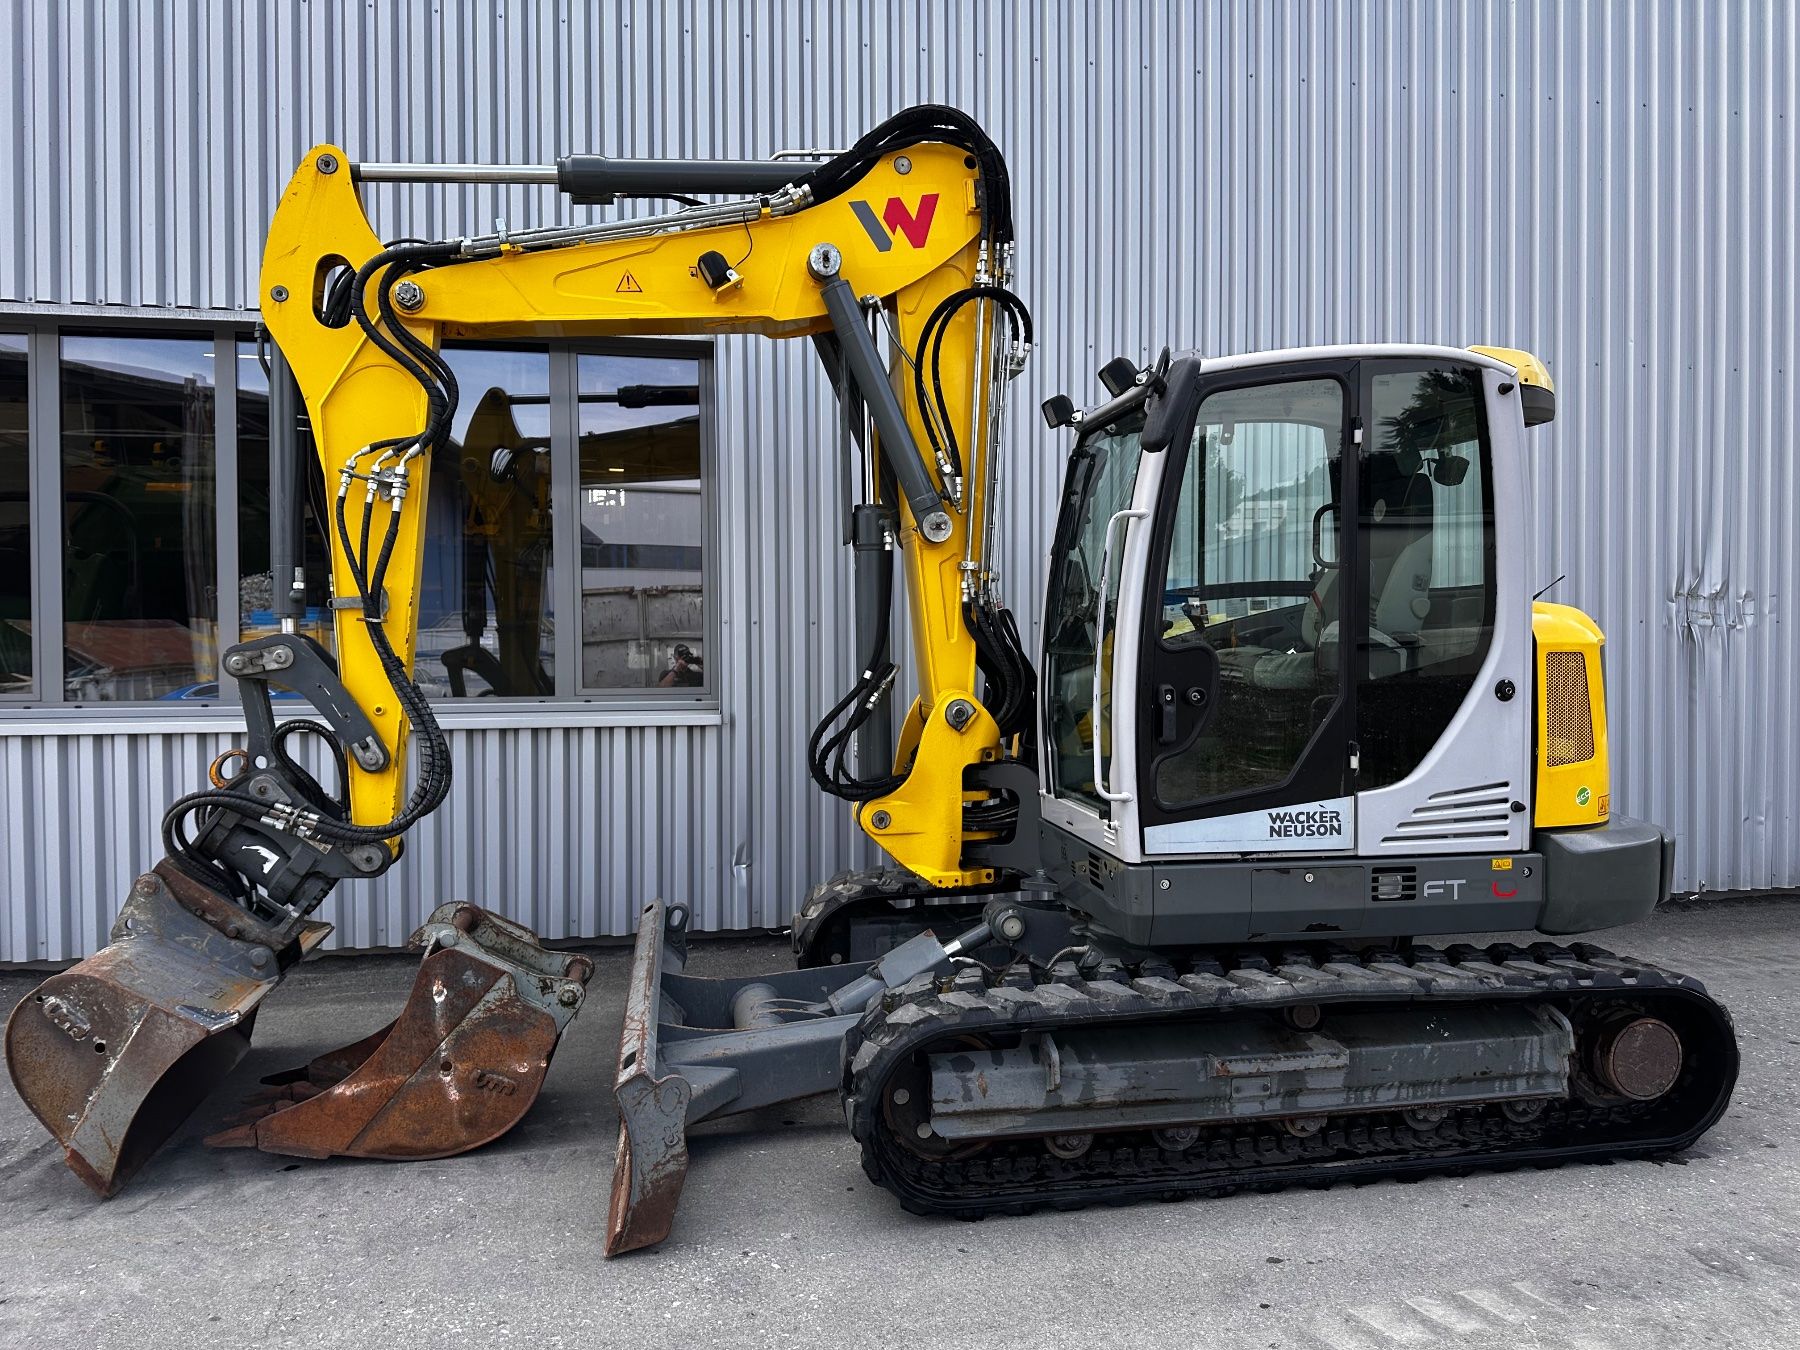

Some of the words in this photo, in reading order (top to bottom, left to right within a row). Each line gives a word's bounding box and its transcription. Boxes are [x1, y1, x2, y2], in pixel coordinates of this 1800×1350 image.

[848, 193, 940, 253] W
[1267, 810, 1342, 825] WACKER
[1269, 823, 1342, 838] NEUSON
